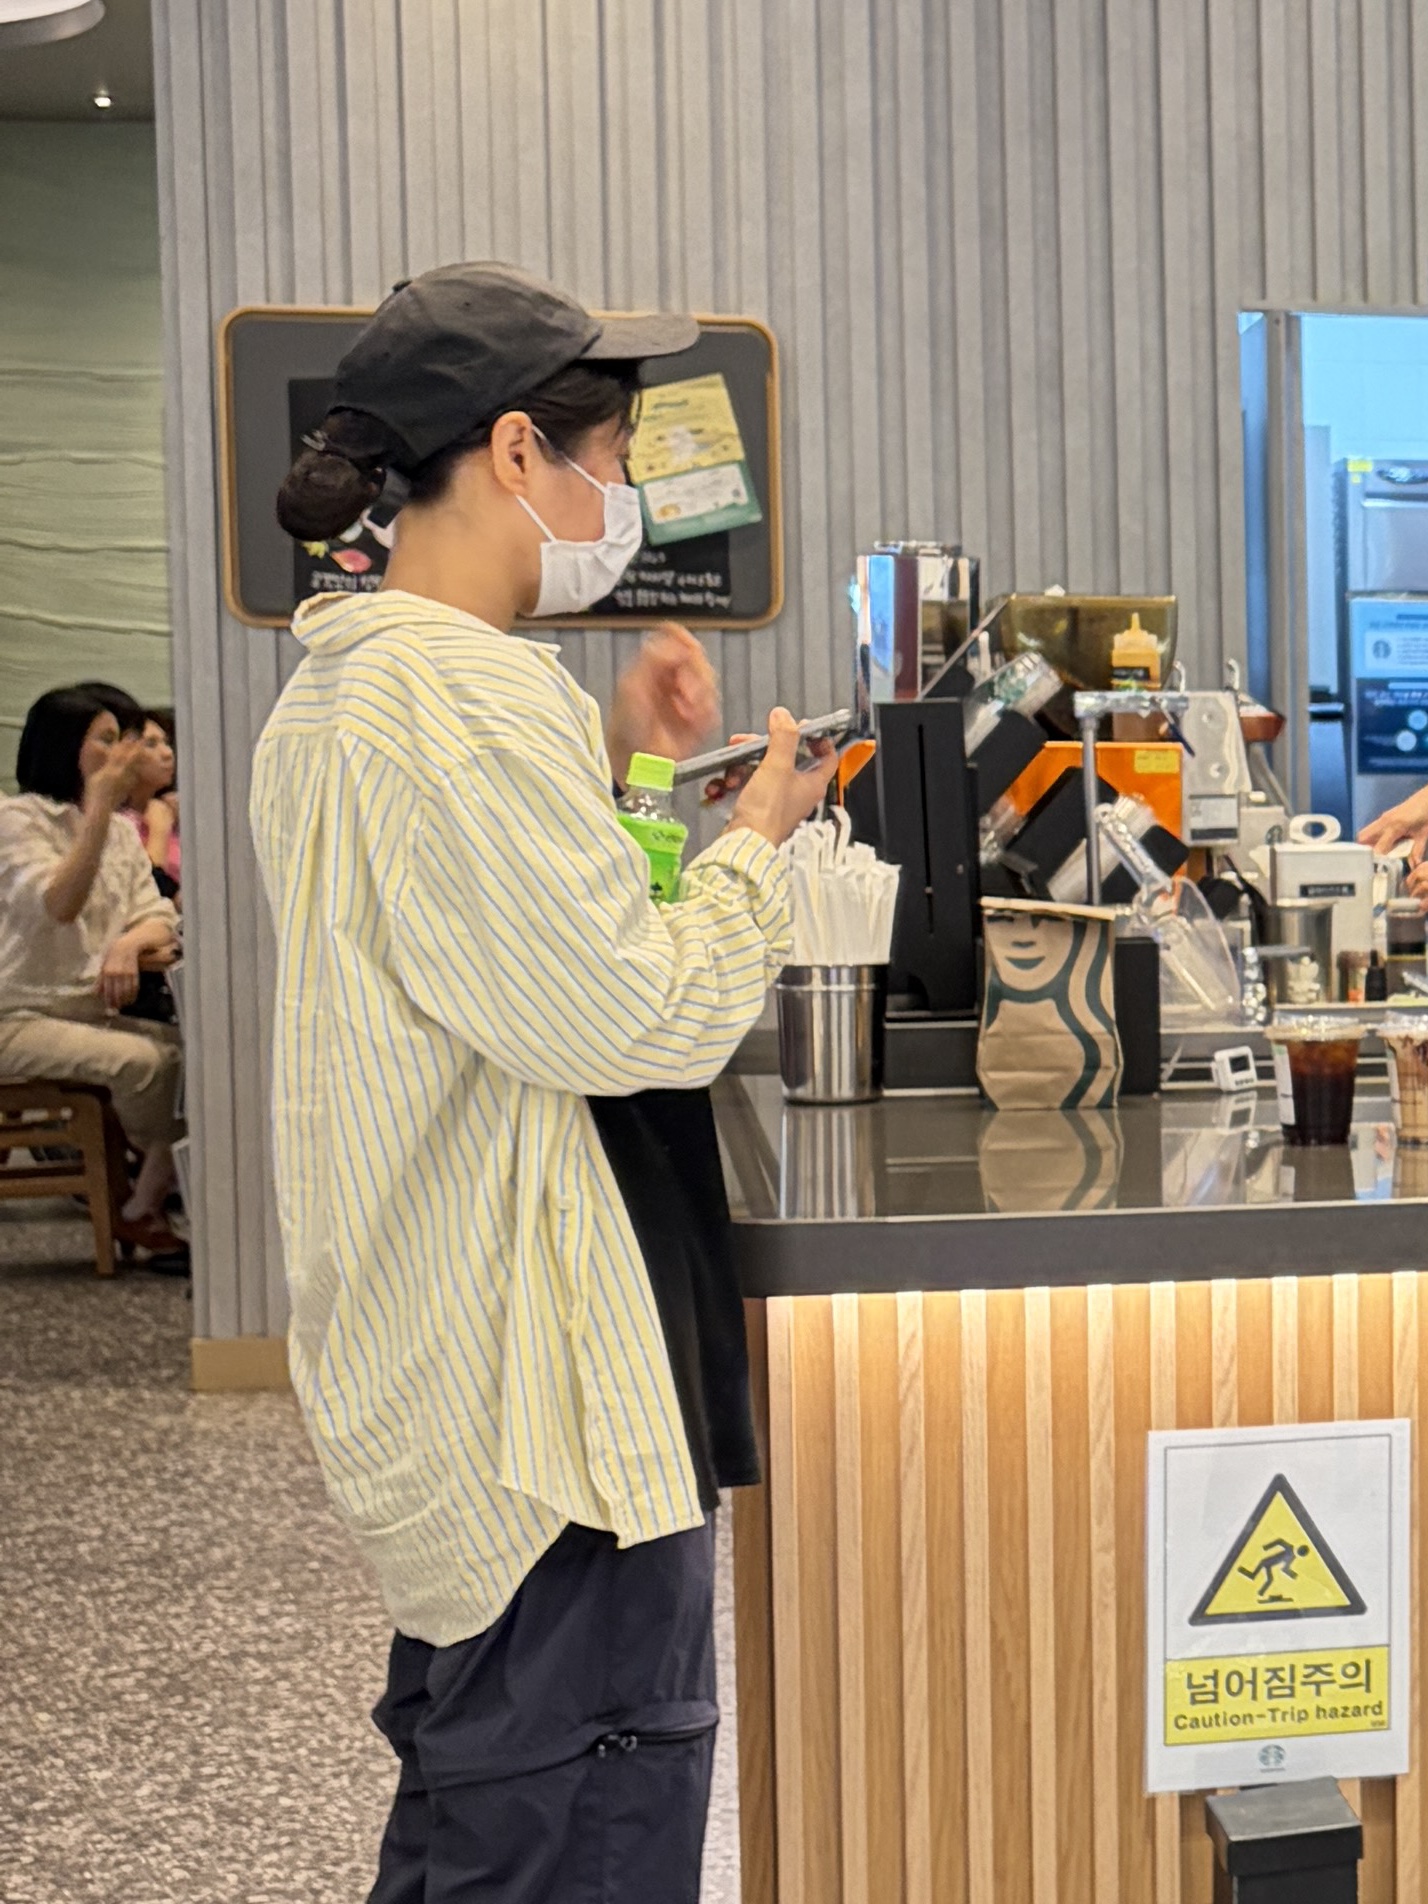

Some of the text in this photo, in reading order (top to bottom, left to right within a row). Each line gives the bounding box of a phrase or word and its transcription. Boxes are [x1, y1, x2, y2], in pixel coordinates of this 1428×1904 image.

[1186, 1658, 1372, 1706] 넘어짐주의
[1174, 1701, 1384, 1732] Caution-Trip hazard
